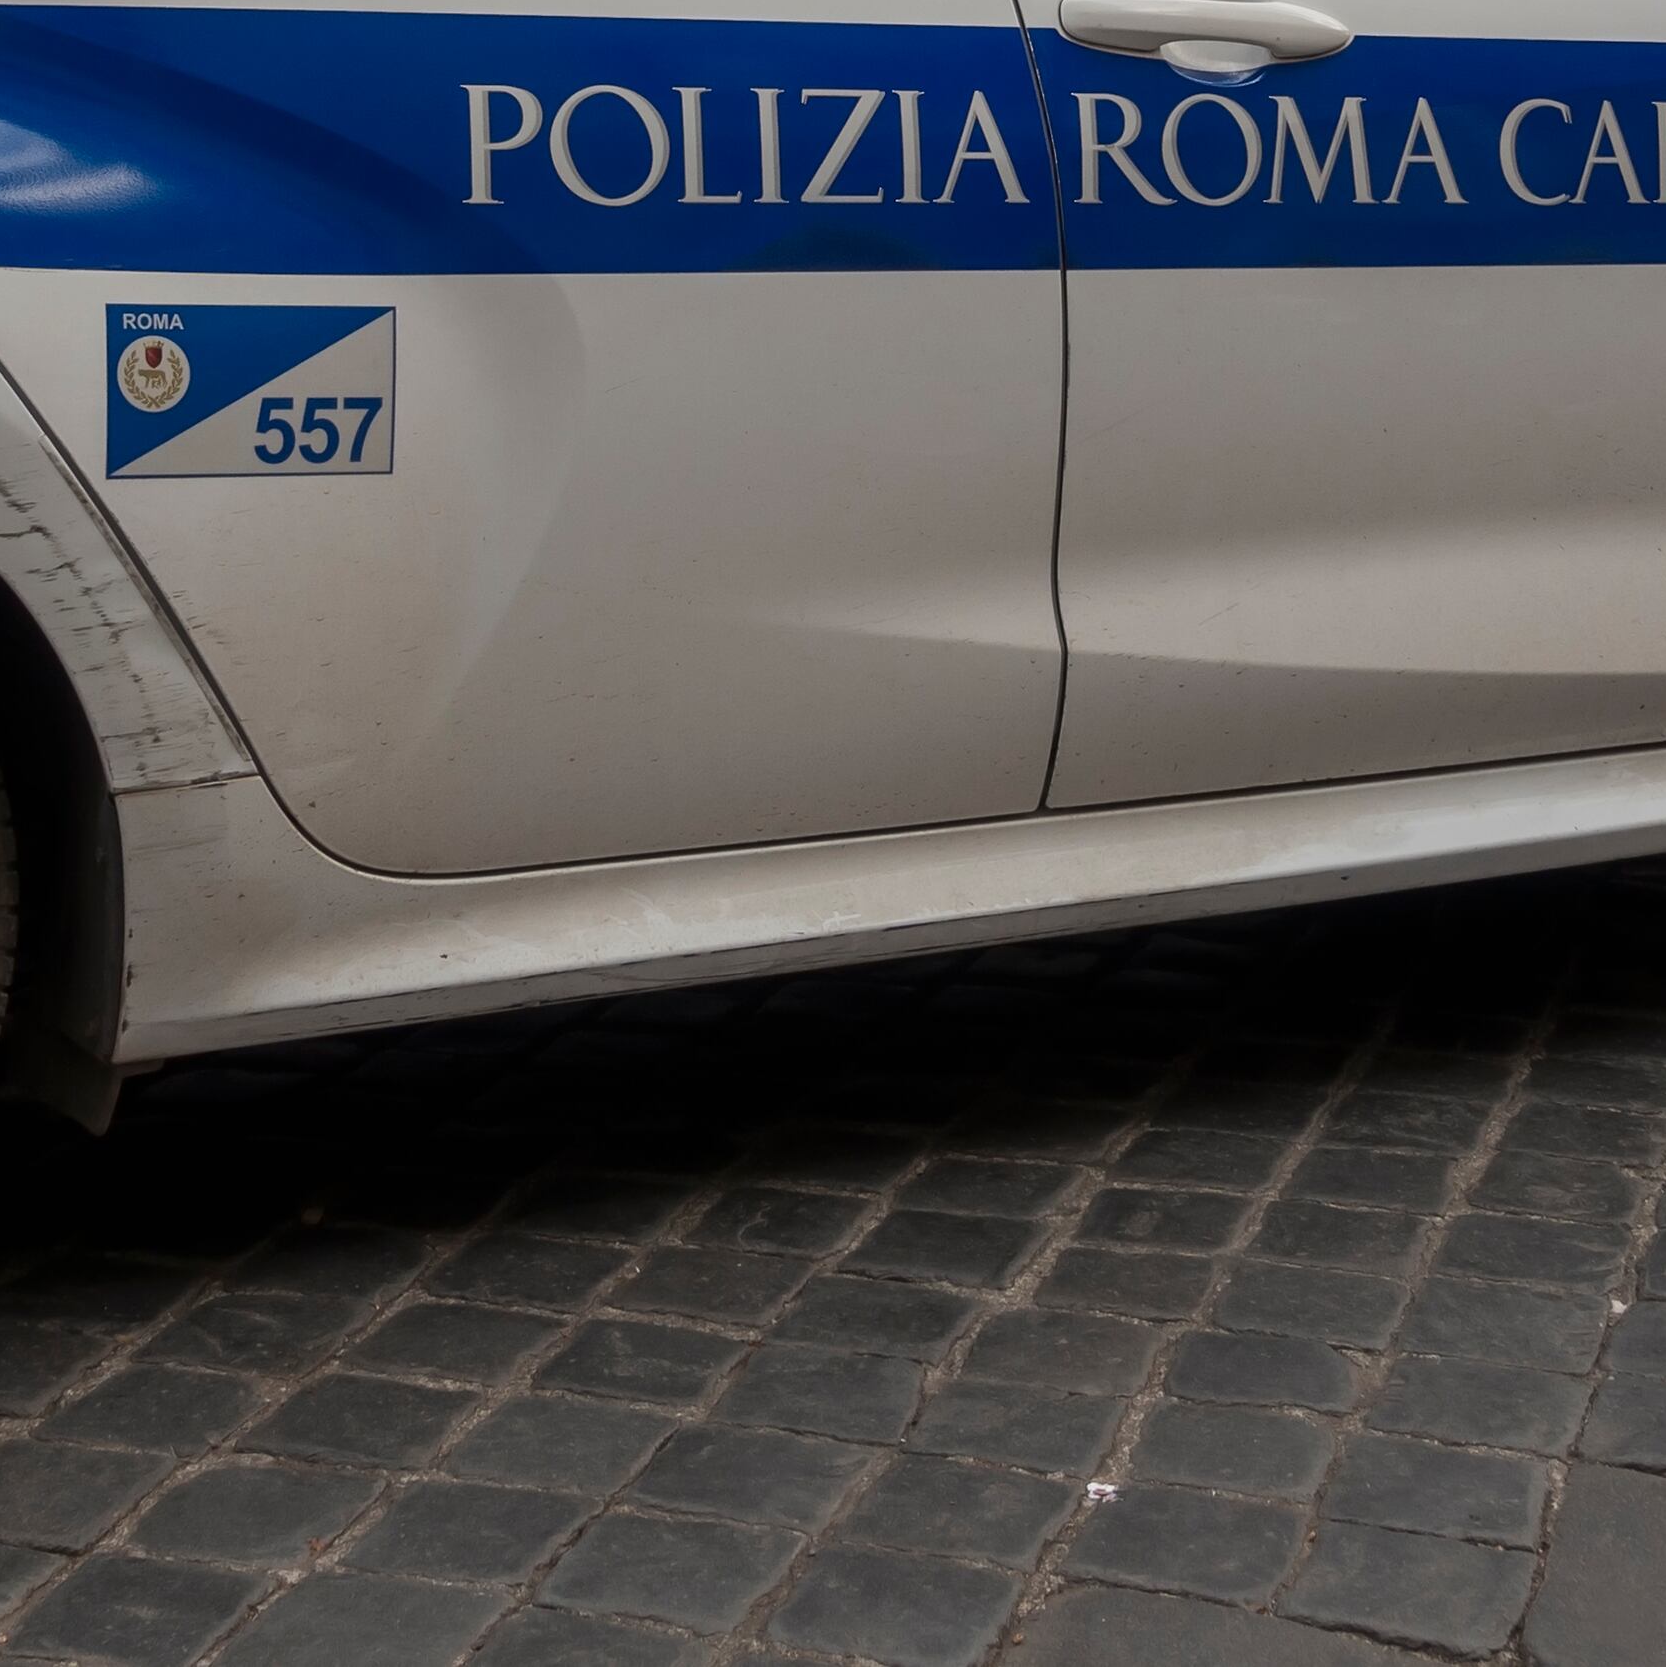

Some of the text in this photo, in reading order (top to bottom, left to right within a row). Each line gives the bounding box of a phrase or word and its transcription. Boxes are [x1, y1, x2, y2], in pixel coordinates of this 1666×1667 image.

[459, 84, 1031, 207] POLIZIA
[1070, 92, 1470, 207] ROMA
[122, 312, 185, 331] ROMA
[253, 396, 384, 465] 557
